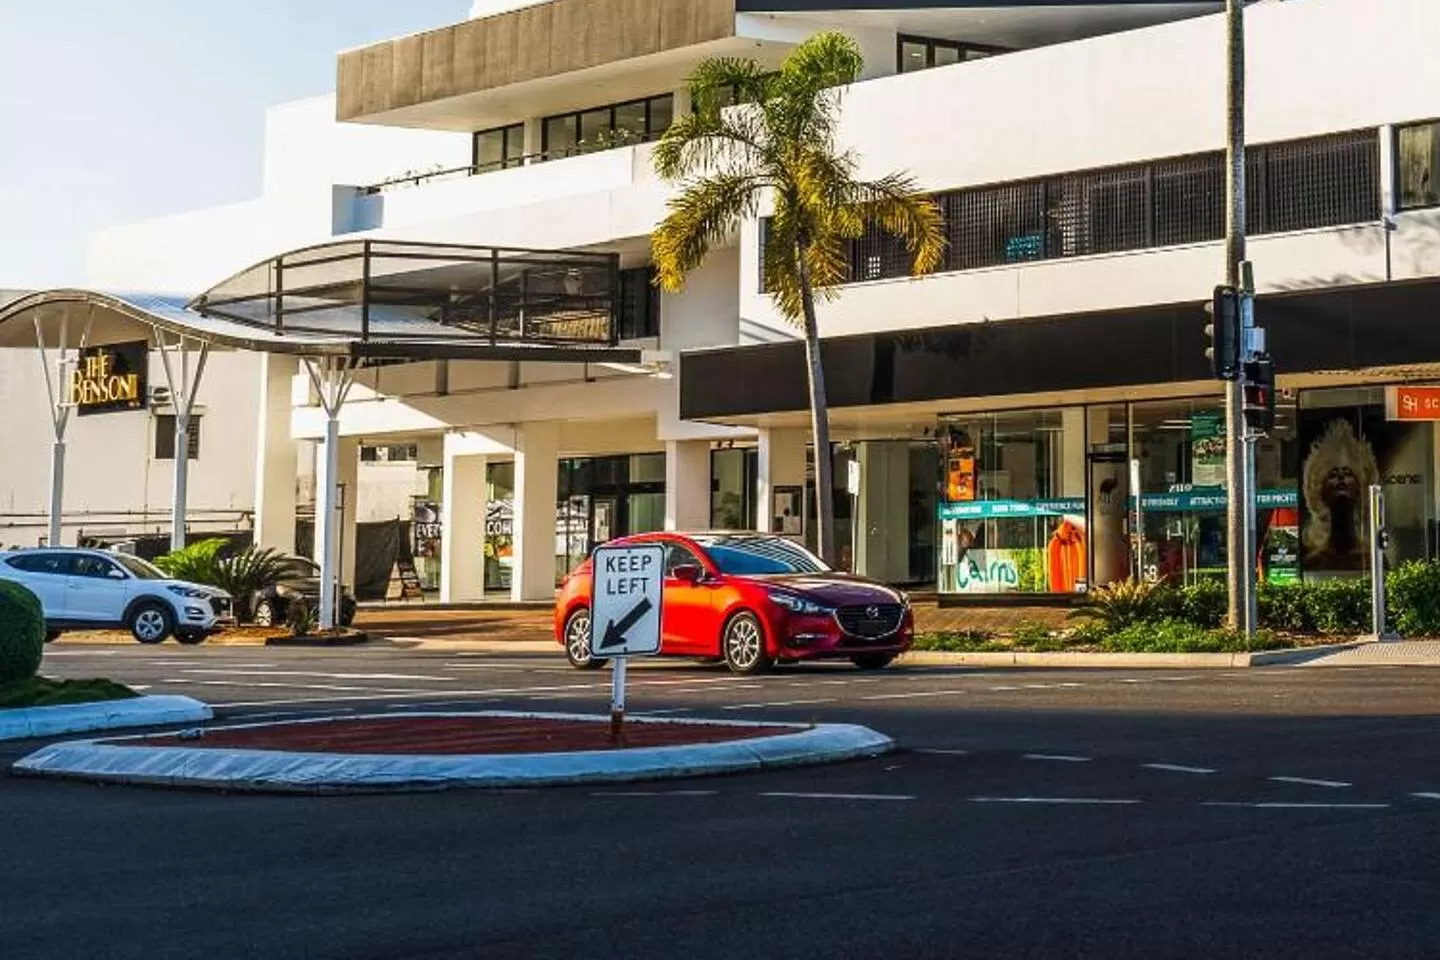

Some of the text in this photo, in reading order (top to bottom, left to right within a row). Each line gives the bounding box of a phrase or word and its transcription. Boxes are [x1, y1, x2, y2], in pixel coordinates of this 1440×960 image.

[85, 354, 109, 378] THE
[70, 370, 138, 404] BENSON
[606, 555, 652, 573] KEEP
[606, 577, 650, 595] LEFT
